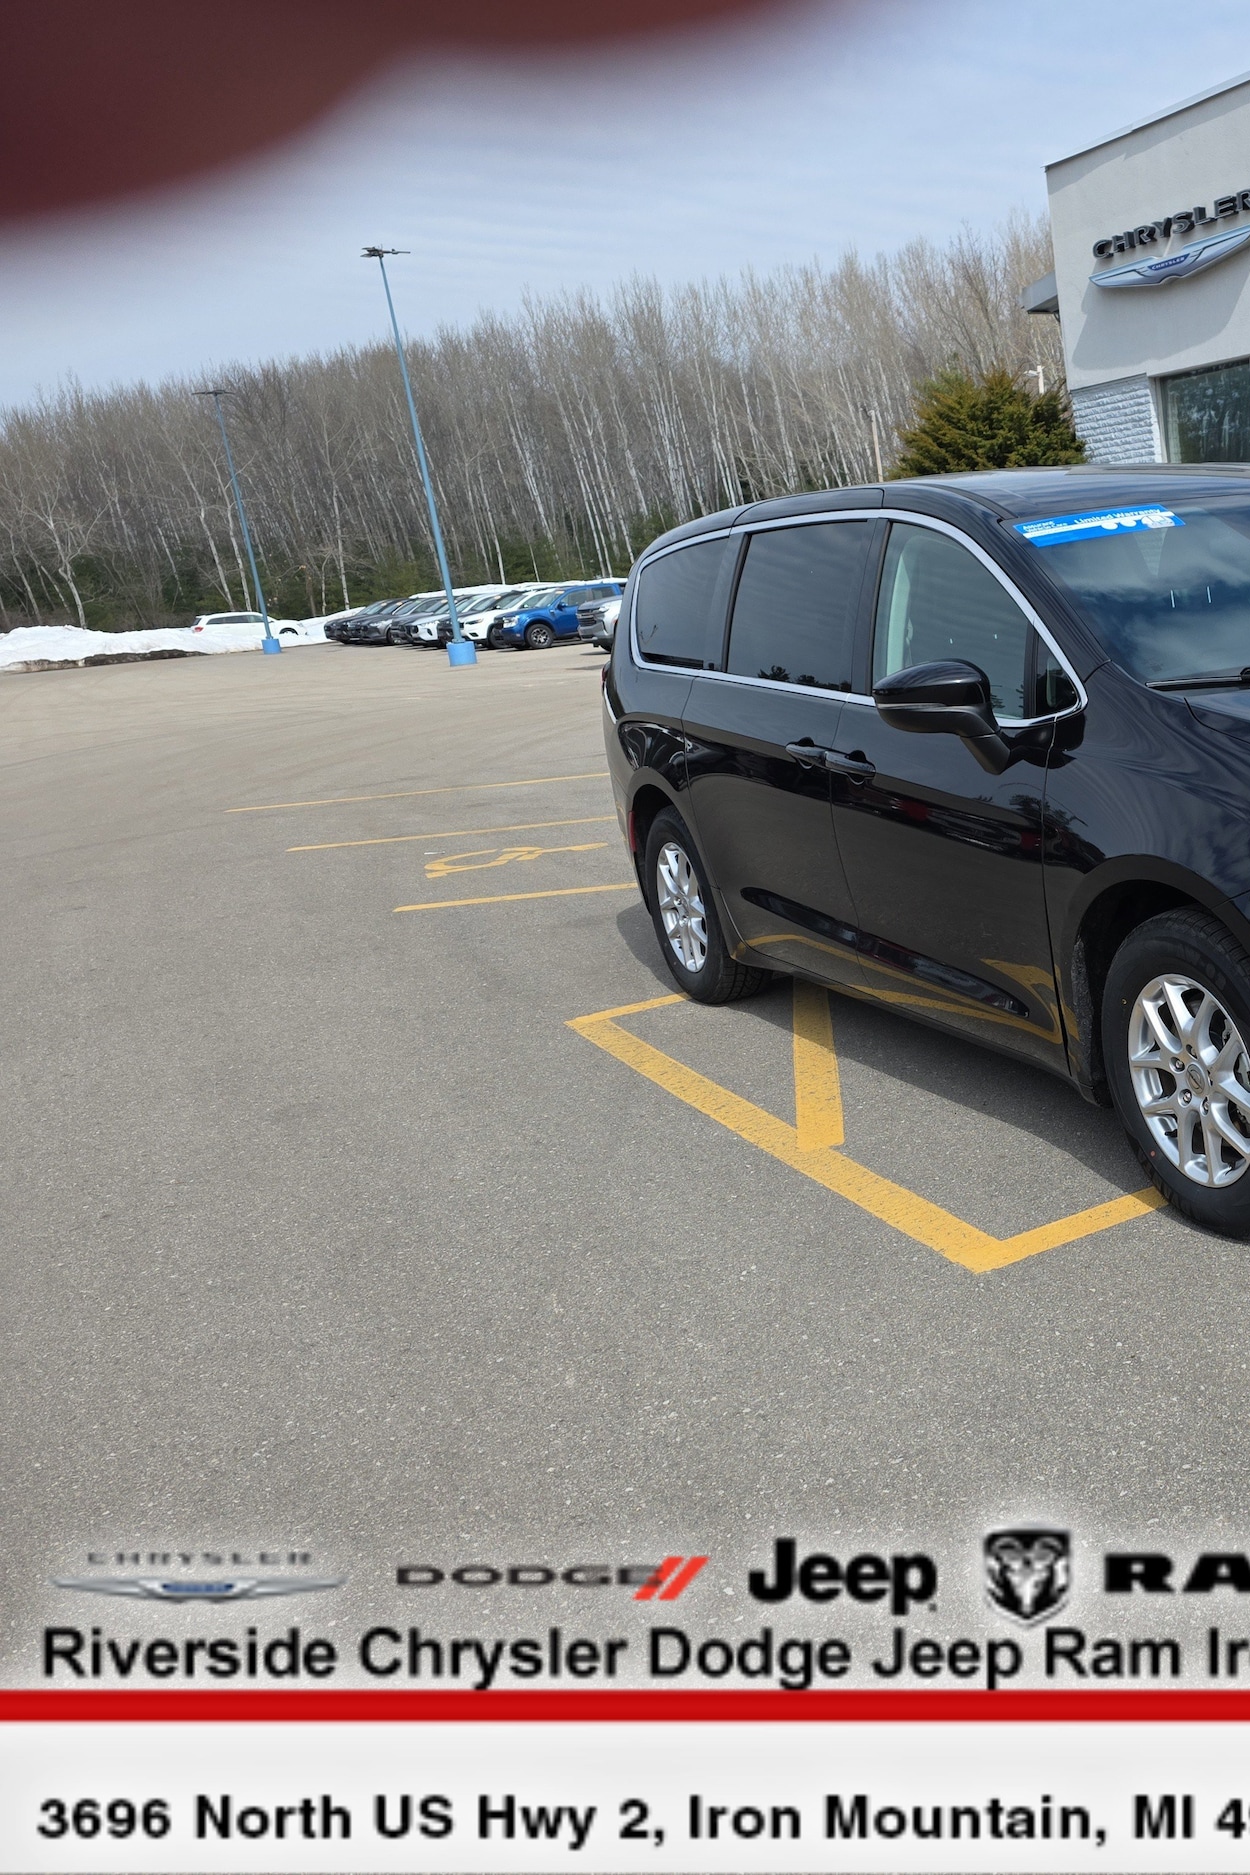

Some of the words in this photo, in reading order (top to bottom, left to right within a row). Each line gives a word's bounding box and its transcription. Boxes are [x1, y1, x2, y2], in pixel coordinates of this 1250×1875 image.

[1150, 256, 1186, 271] CHRYSLER
[1074, 512, 1112, 525] Limited
[1113, 507, 1161, 520] Warranty
